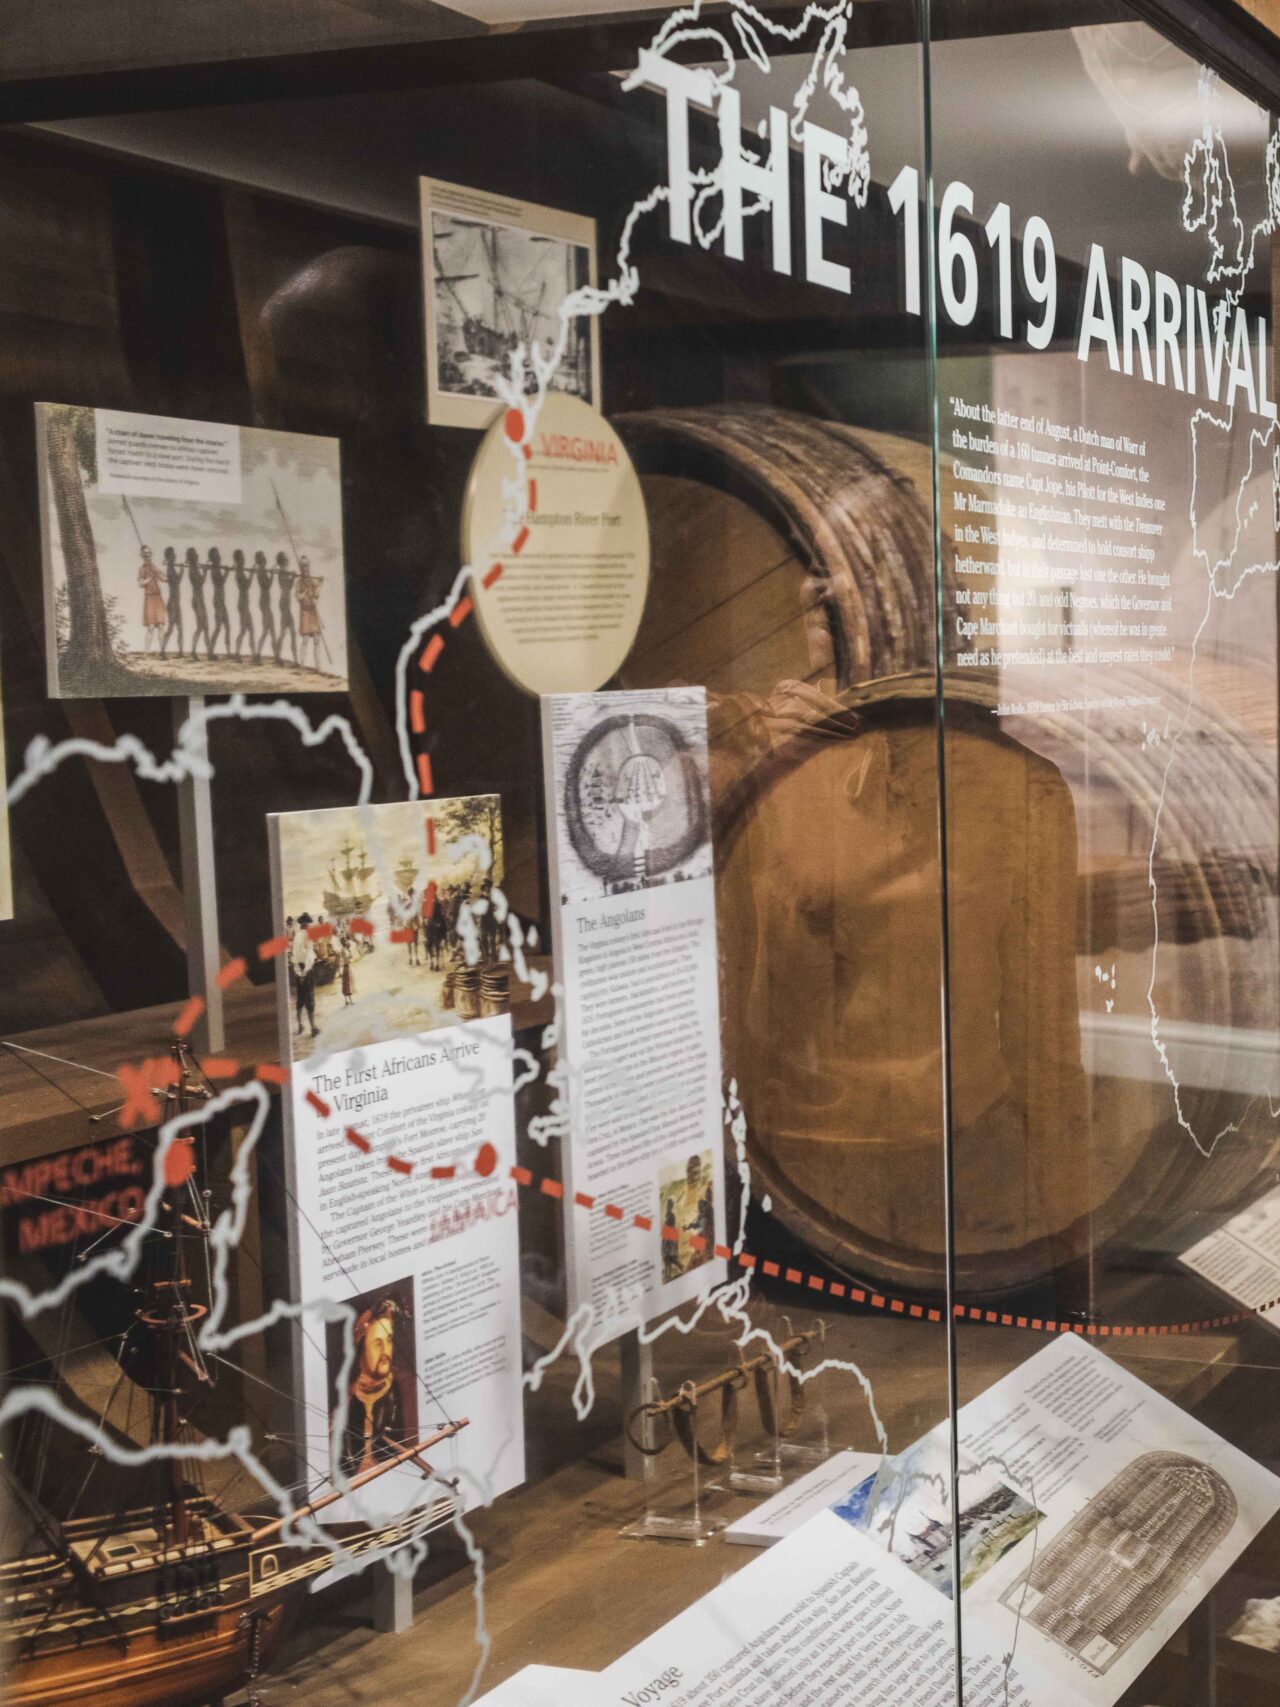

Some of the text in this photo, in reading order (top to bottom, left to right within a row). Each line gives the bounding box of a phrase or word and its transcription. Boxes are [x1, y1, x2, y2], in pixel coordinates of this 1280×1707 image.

[638, 48, 1277, 419] THE 1619 ARRIVAL
[540, 433, 618, 464] VIRGINIA
[981, 404, 996, 424] the
[997, 408, 1018, 429] latter
[1020, 415, 1034, 432] end
[1036, 417, 1044, 433] of
[1045, 419, 1072, 443] August,
[1073, 430, 1078, 442] a
[1079, 426, 1099, 446] Dutch
[1101, 436, 1114, 449] man
[1116, 436, 1122, 451] of
[1123, 436, 1138, 455] Warr
[1138, 441, 1146, 457] of
[952, 430, 968, 449] the
[969, 432, 999, 454] burden
[1000, 439, 1008, 457] of
[1010, 446, 1015, 458] a
[1017, 442, 1030, 460] 160
[1031, 447, 1056, 465] tunnes
[1058, 453, 1083, 471] arrived
[1084, 459, 1091, 472] at
[1138, 467, 1150, 483] the
[953, 460, 1001, 485] Comandors
[1003, 474, 1024, 489] name
[1026, 473, 1044, 495] Capt
[1066, 480, 1076, 497] his
[1097, 486, 1106, 501] for
[1107, 487, 1119, 503] the
[1119, 489, 1135, 506] West
[1154, 500, 1166, 511] one
[953, 491, 1134, 532] Mr Marmaduke an They with the
[954, 523, 1000, 545] in the West
[1088, 539, 1095, 554] to
[1096, 539, 1112, 556] hold
[1113, 544, 1136, 559] consort
[1094, 571, 1106, 582] one
[1107, 568, 1119, 583] the
[1138, 569, 1147, 585] He
[955, 589, 988, 609] not any
[1054, 592, 1068, 607] odd
[1120, 594, 1132, 609] the
[956, 617, 978, 639] Cape
[1129, 624, 1141, 636] was
[957, 648, 1001, 666] need as he
[576, 909, 646, 934] The Angolans
[312, 1073, 342, 1094] The
[345, 1065, 378, 1087] First
[380, 1050, 437, 1079] Africans
[333, 1086, 389, 1112] Virginia
[0, 1138, 142, 1207] MPECHE,
[19, 1187, 146, 1252] MEXICO
[333, 1231, 369, 1251] Governor
[685, 1561, 860, 1700] about captured Angolans were sold to Spanish Captain
[736, 1580, 881, 1698] Cruz in The aboard were rank
[795, 1586, 895, 1671] only an inch wide space chained
[819, 1597, 904, 1671] reached port Some
[850, 1628, 892, 1662] for Vera Cruz
[706, 1616, 815, 1702] Port Luanda and taken aboard his
[858, 1619, 945, 1698] search Captain Jope
[906, 1637, 948, 1674] right piracy
[966, 1654, 993, 1676] The two
[620, 1664, 684, 1707] Voyage
